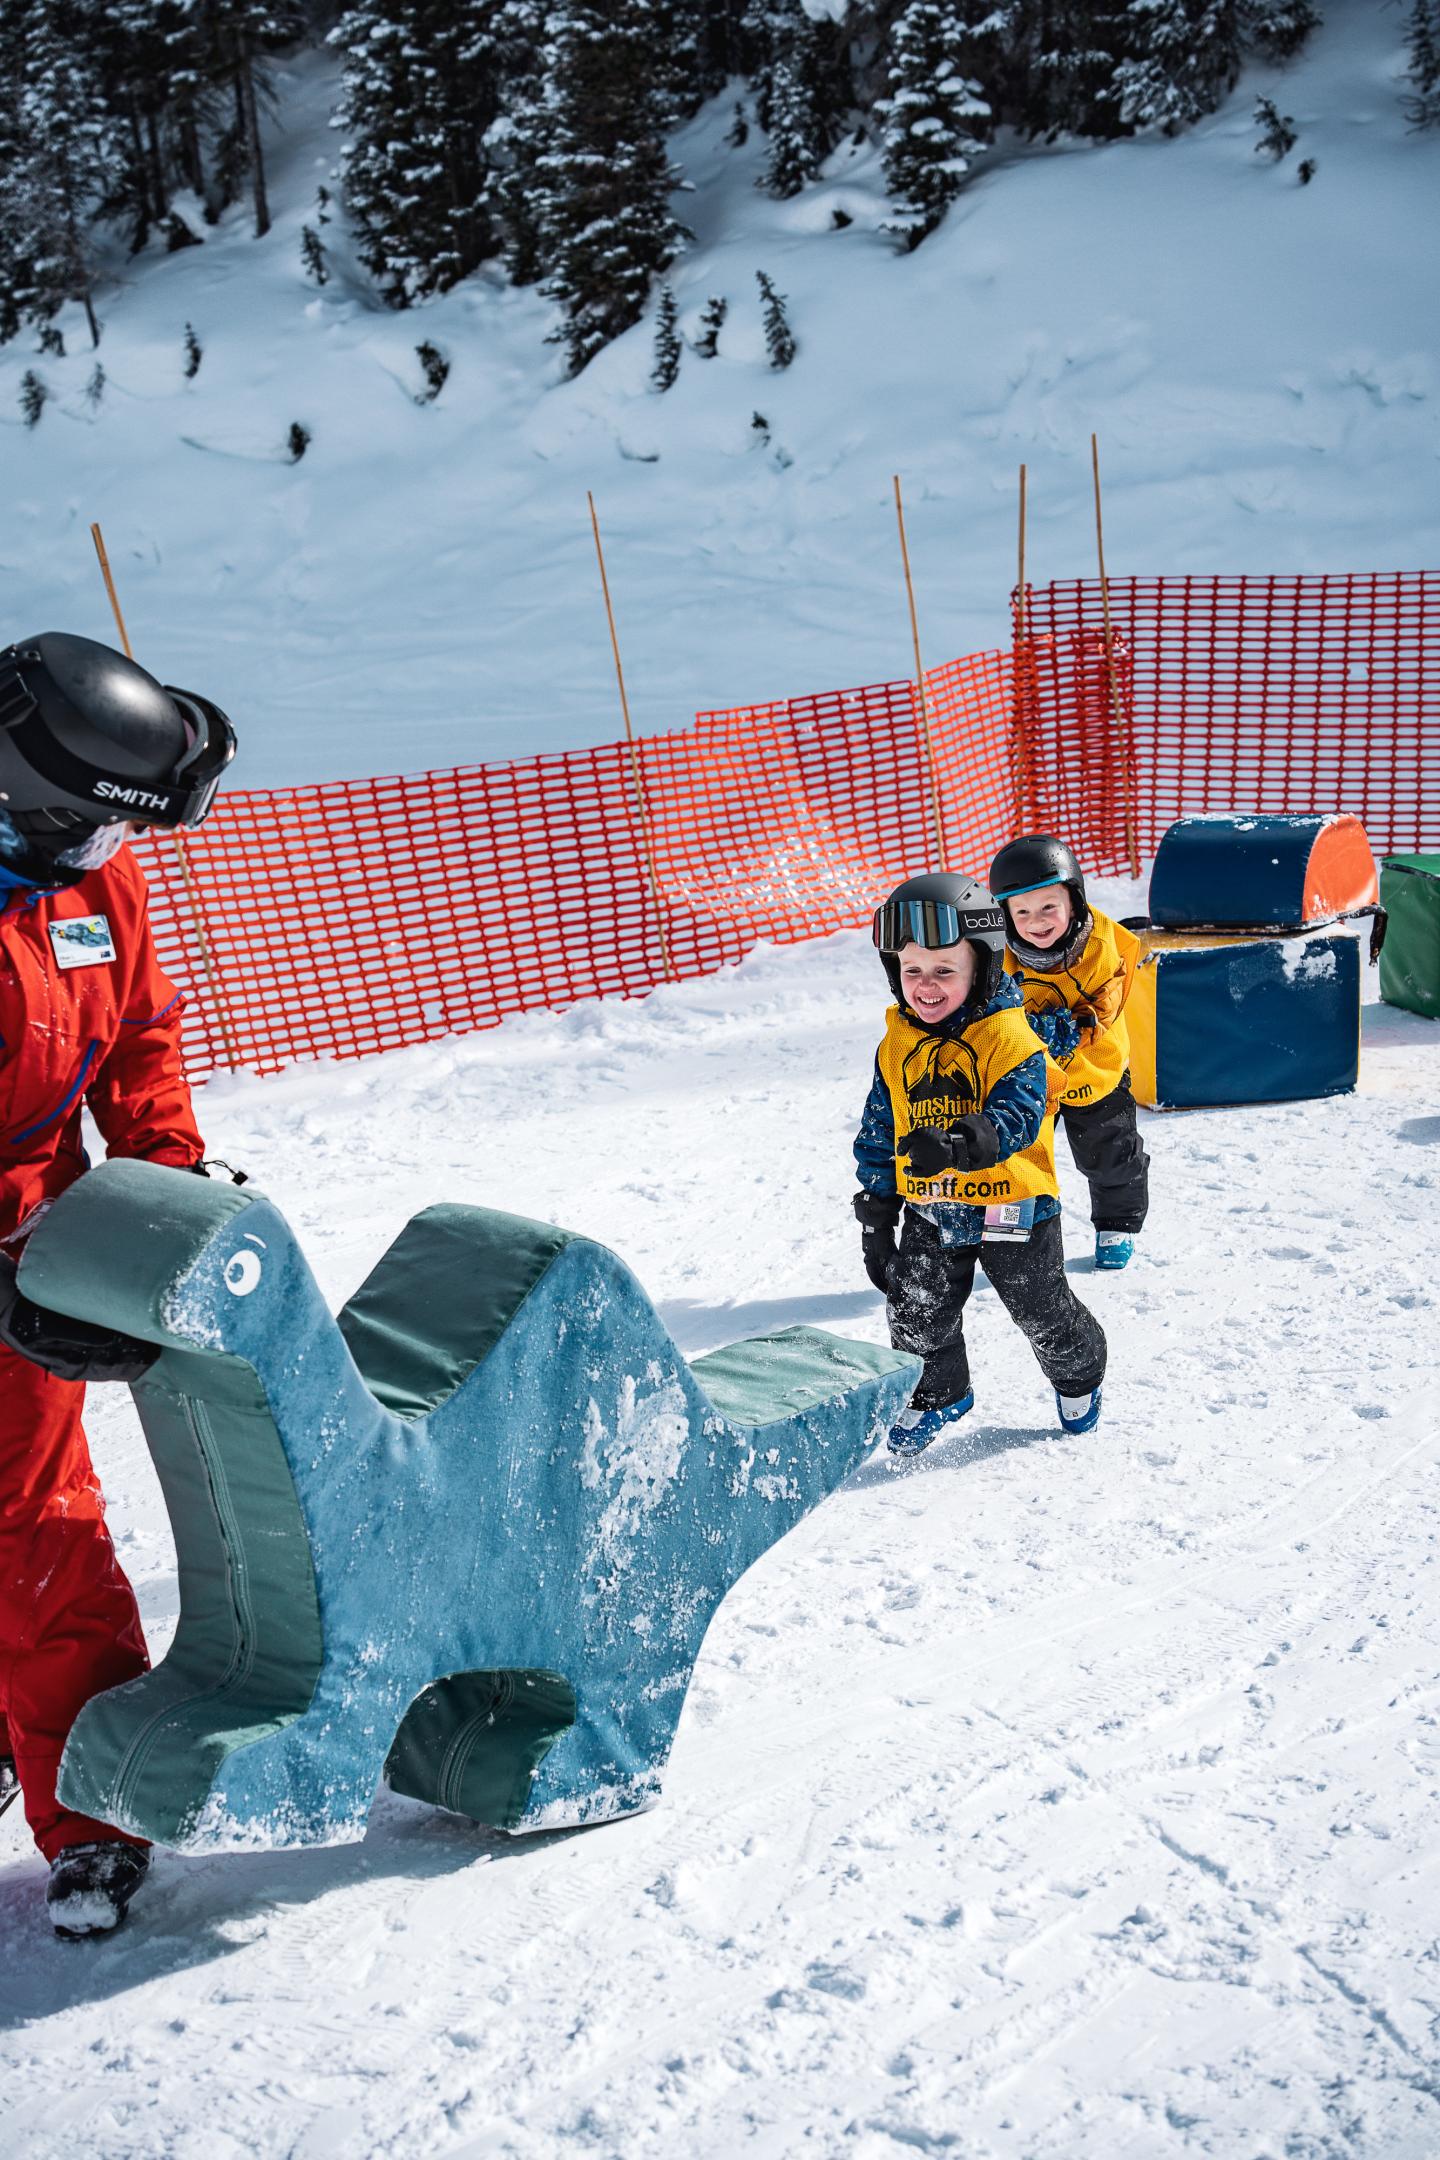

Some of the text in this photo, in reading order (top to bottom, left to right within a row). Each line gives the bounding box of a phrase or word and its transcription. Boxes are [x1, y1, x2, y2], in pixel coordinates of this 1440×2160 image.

[92, 781, 170, 811] SMITH
[964, 912, 1004, 929] bollé
[906, 1176, 1011, 1198] banff.com
